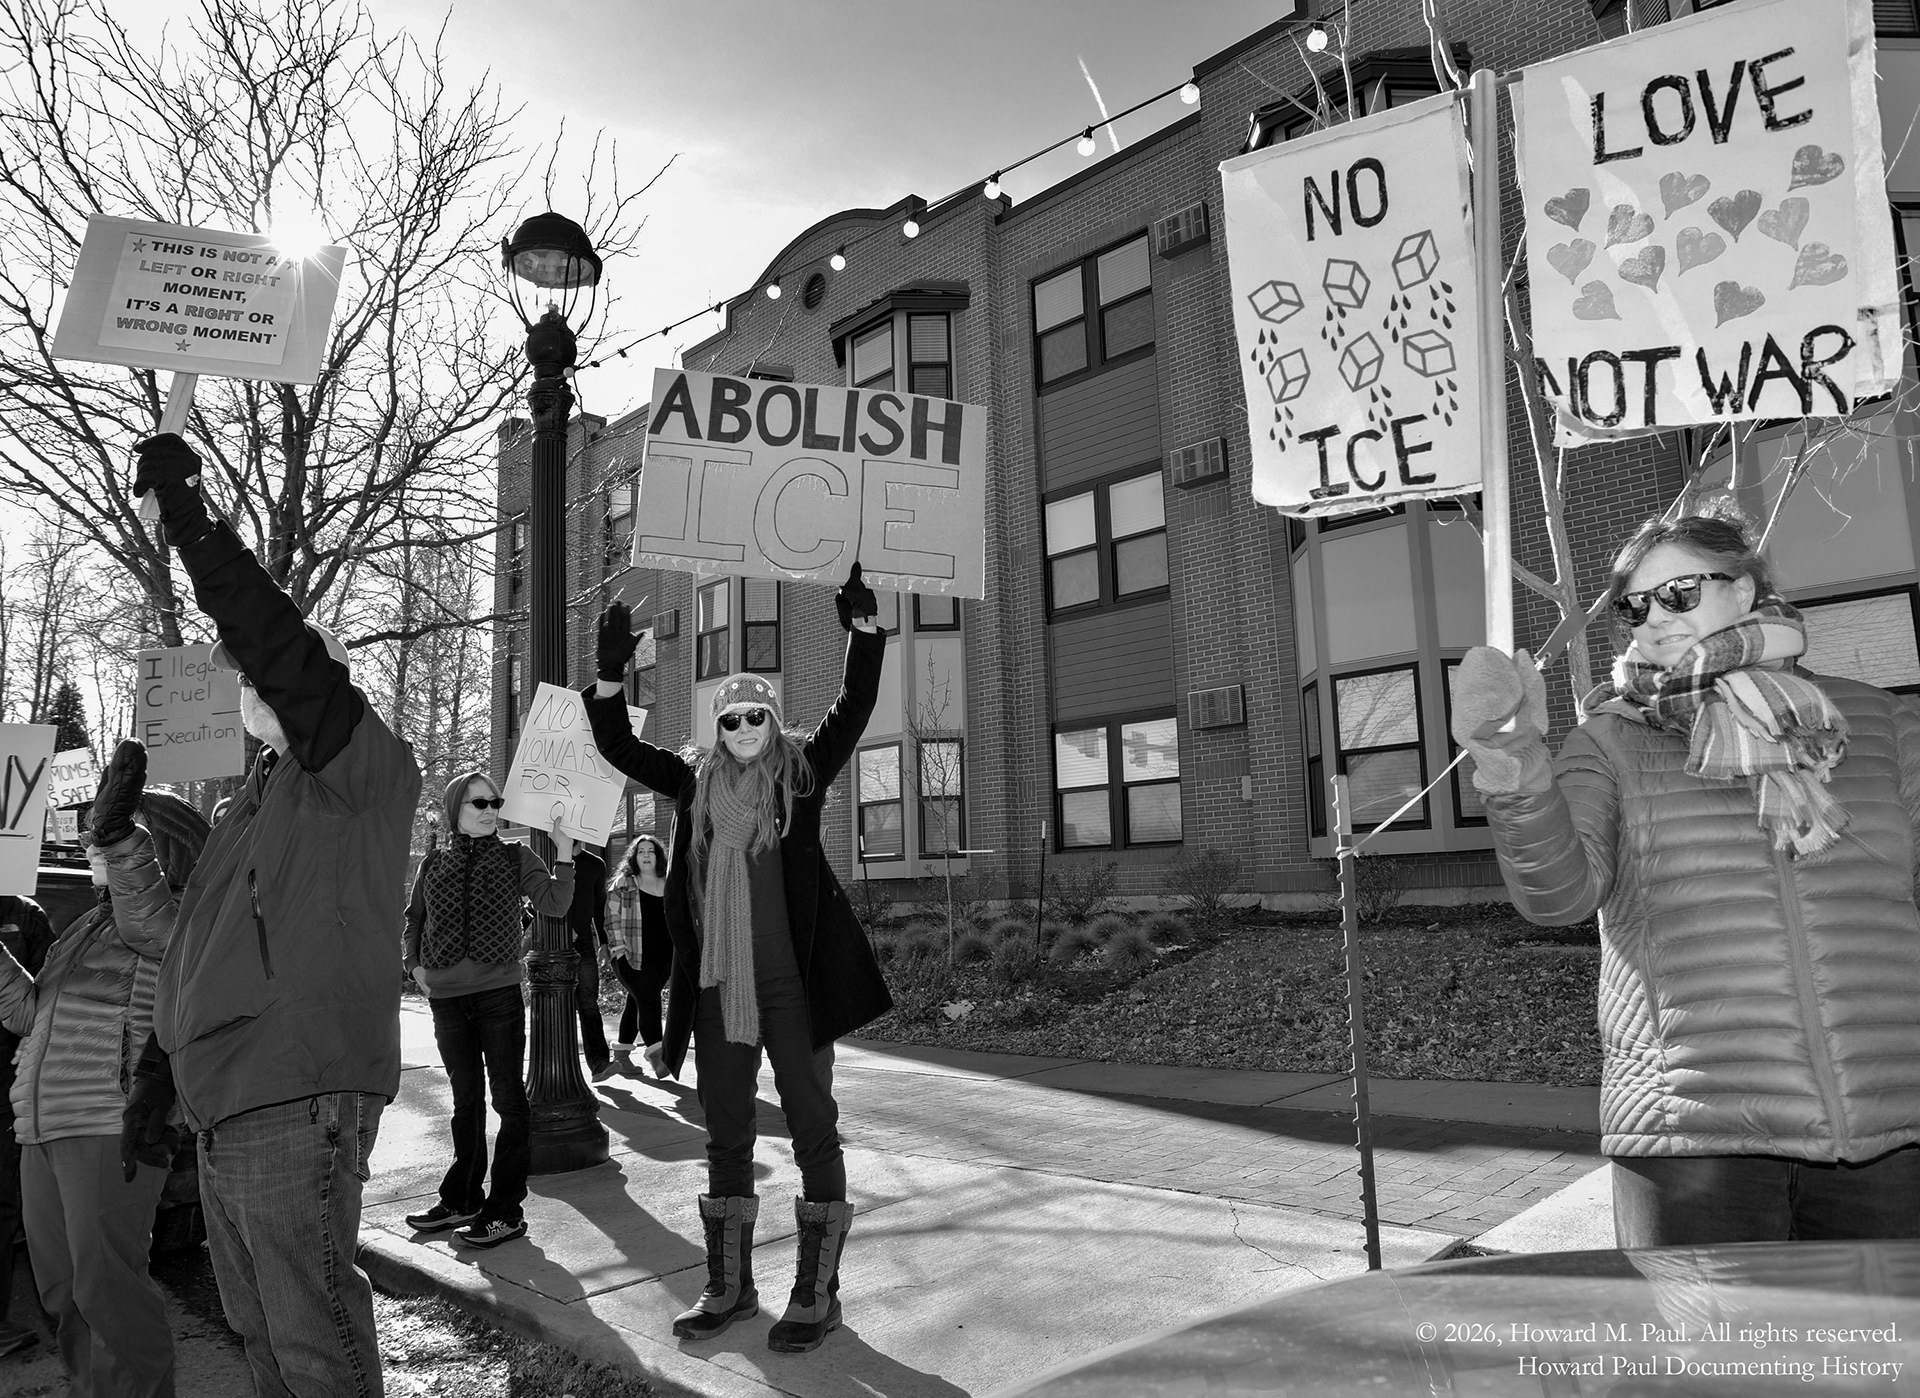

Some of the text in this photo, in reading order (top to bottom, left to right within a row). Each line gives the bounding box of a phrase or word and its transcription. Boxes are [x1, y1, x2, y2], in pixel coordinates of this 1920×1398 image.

[1590, 47, 1813, 165] LOVE
[1304, 157, 1388, 241] NO
[151, 241, 277, 266] THIS IS NOT A
[139, 260, 281, 287] LEFT OR RIGHT
[162, 282, 247, 304] MOMENT,
[116, 316, 188, 335] WRONG
[125, 298, 275, 325] IT'S A RIGHT OR
[1534, 345, 1681, 429] NOT
[1695, 324, 1857, 416] WAR
[648, 373, 964, 466] ABOLISH
[1298, 414, 1436, 499] ICE
[639, 440, 960, 580] ICE
[145, 655, 224, 681] Illega
[146, 681, 211, 708] Cruel
[533, 693, 577, 730] NO
[146, 722, 237, 748] Execution
[61, 784, 95, 806] SAFE
[520, 769, 572, 798] FOR
[550, 800, 598, 832] OIL
